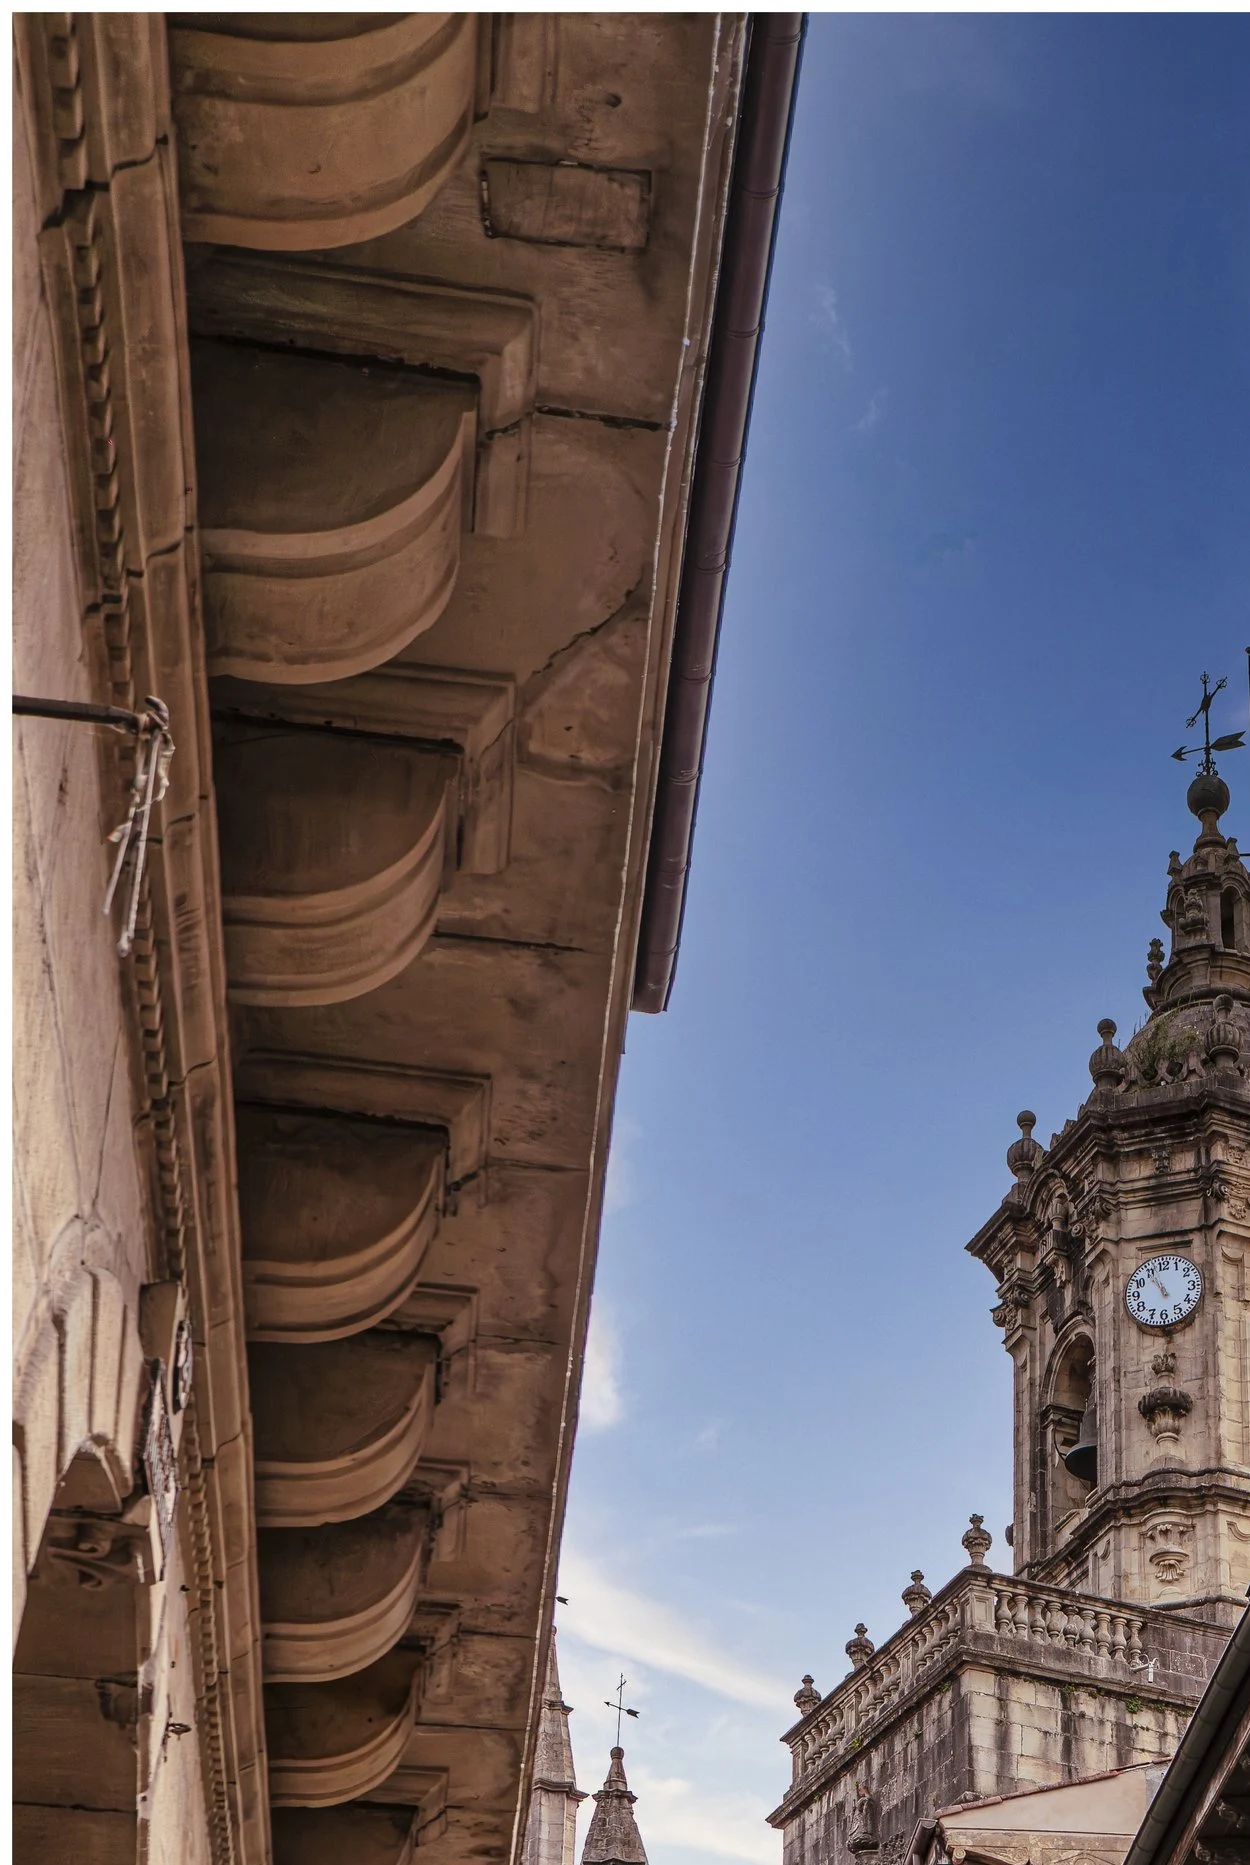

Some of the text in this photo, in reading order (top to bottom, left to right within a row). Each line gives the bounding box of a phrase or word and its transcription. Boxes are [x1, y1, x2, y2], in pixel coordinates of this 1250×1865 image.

[1158, 1260, 1170, 1272] 12
[1173, 1261, 1179, 1271] 1
[1182, 1266, 1191, 1278] 2
[1135, 1277, 1146, 1289] 10
[1187, 1280, 1196, 1291] 3
[1132, 1290, 1141, 1301] 9
[1183, 1293, 1193, 1304] 4
[1136, 1301, 1146, 1312] 8
[1173, 1303, 1183, 1315] 5
[1148, 1308, 1157, 1320] 7
[1160, 1309, 1169, 1320] 6
